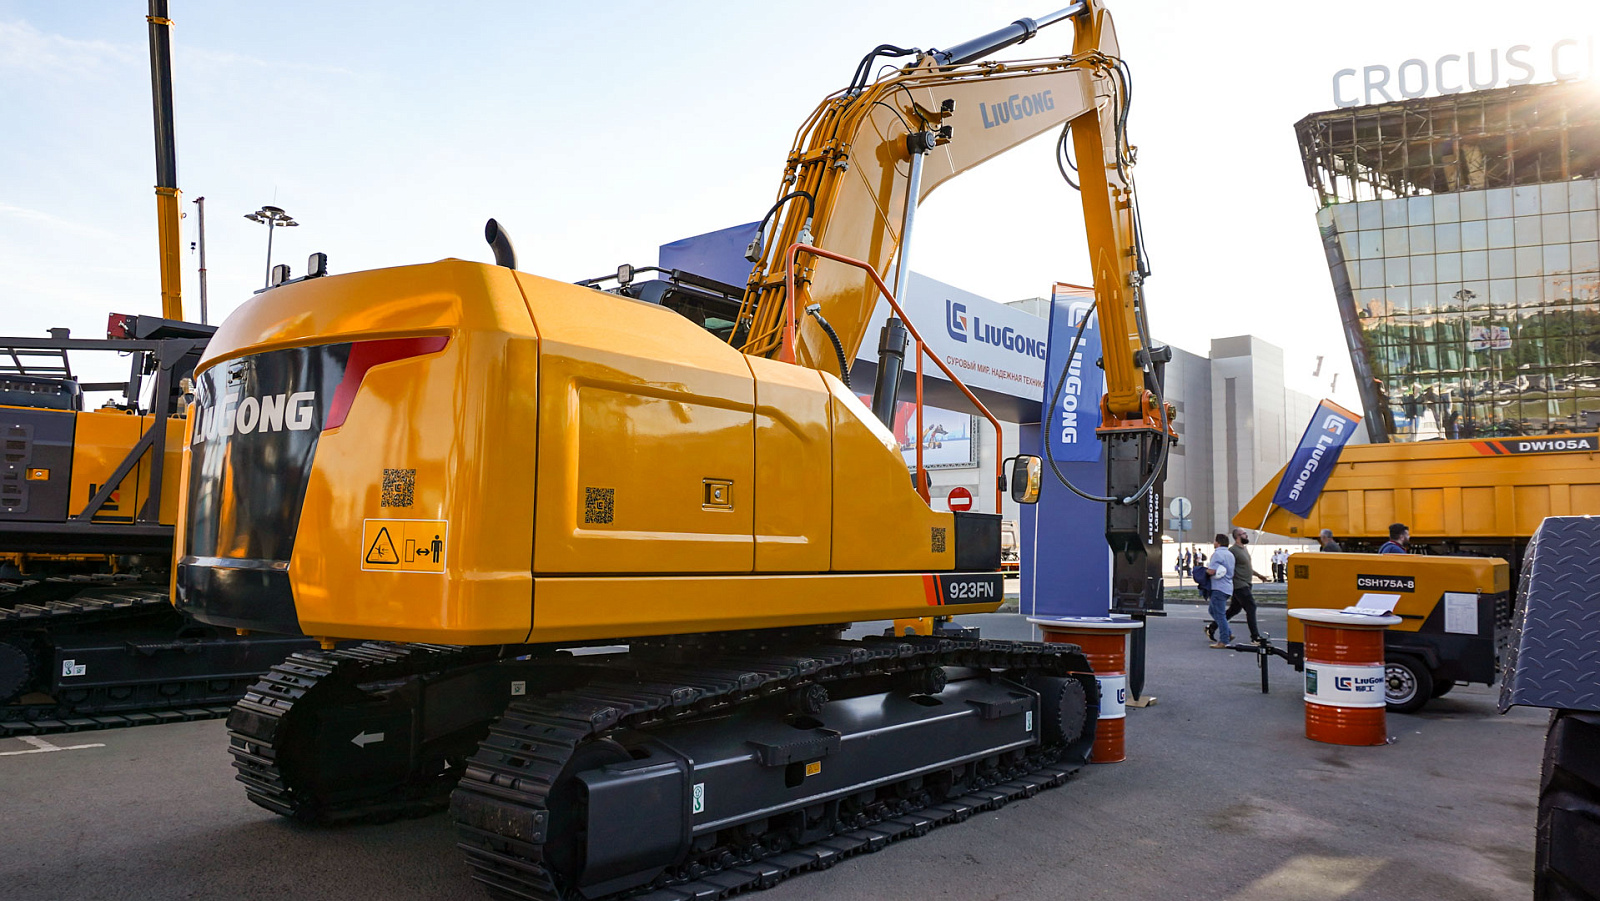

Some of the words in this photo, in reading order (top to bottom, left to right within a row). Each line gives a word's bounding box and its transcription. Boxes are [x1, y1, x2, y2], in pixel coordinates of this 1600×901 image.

[1332, 44, 1536, 109] CROCUS
[946, 355, 976, 372] СУРОВЫЙ
[991, 368, 1022, 382] НАДЕЖНАЯ
[1519, 439, 1591, 452] DW105A
[949, 581, 994, 599] 923FN
[1357, 578, 1415, 589] CSH175A-8
